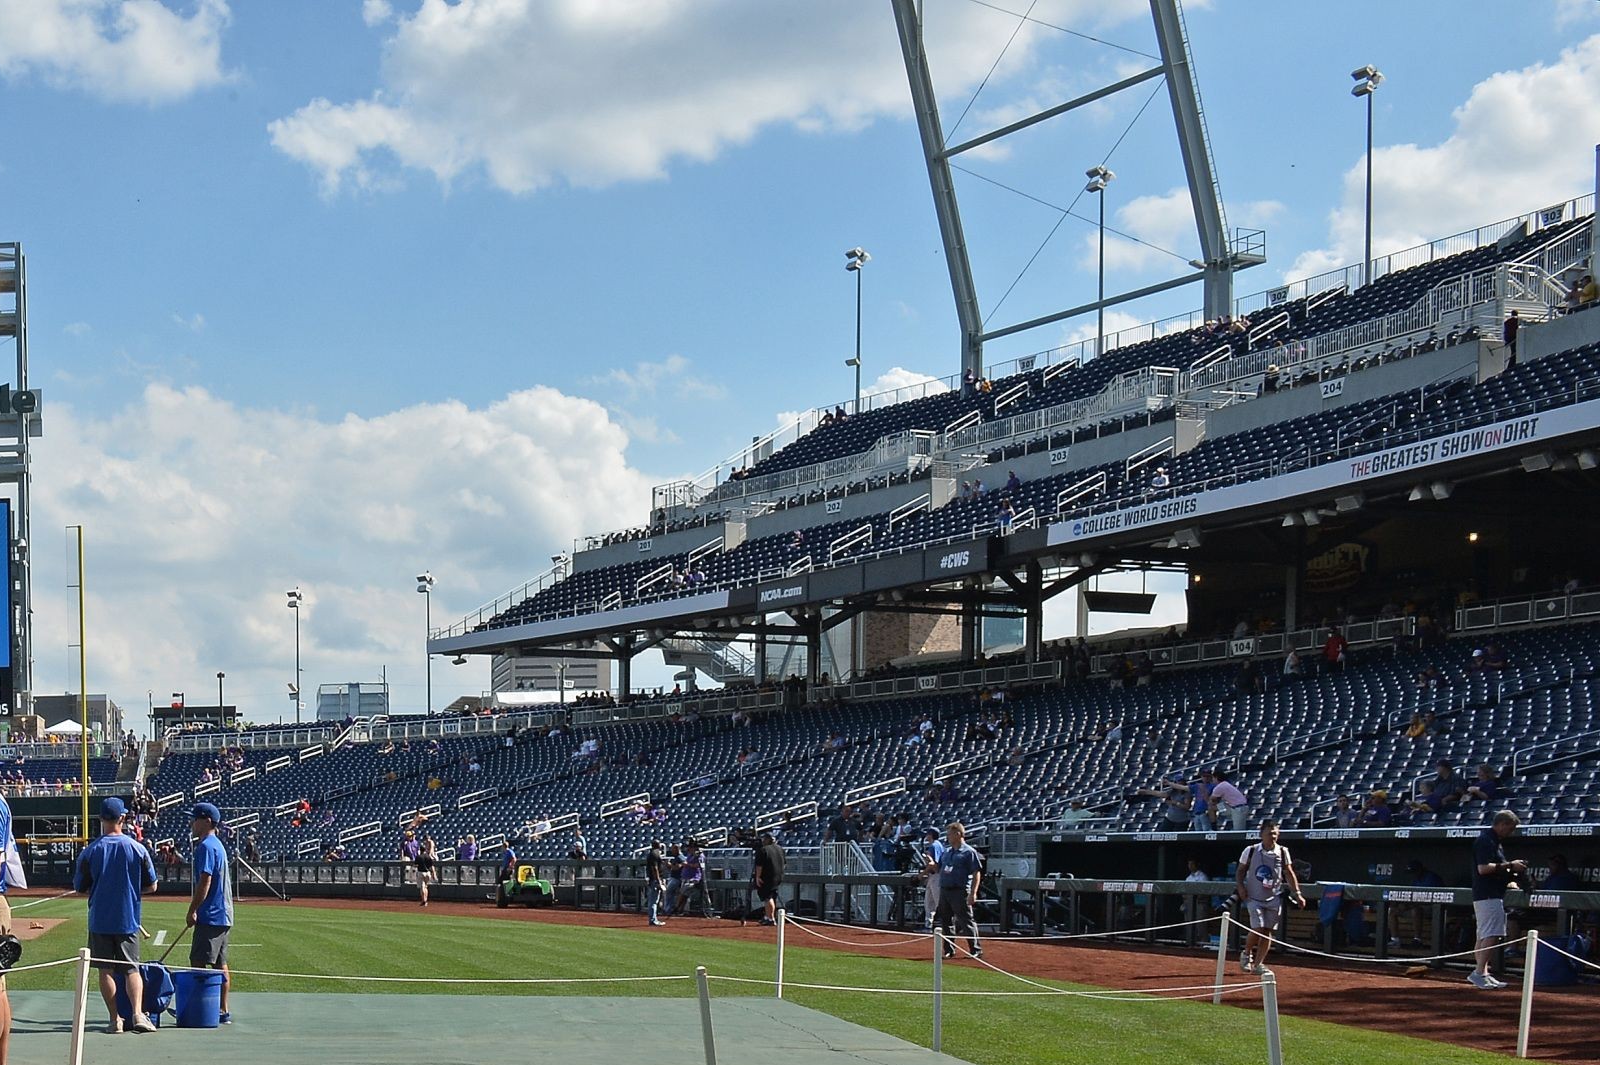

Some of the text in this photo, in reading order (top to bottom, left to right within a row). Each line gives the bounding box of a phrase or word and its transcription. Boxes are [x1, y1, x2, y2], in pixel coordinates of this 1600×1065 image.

[1544, 210, 1561, 223] 303
[1272, 291, 1287, 300] 302
[1323, 382, 1341, 395] 204
[1350, 417, 1539, 478] THE GREATEST SHOW ON DIRT
[1052, 451, 1067, 461] 203
[827, 502, 840, 511] 202
[1082, 499, 1197, 535] COLLEGE WORLD SERIES
[640, 541, 651, 549] 201
[940, 551, 970, 569] #CWS
[761, 586, 802, 602] NCAA.com
[1234, 642, 1251, 652] 104
[921, 679, 934, 687] 103
[1308, 830, 1359, 839] COLLEGE WORLD SERIES
[1395, 830, 1410, 838] #CWS
[1447, 829, 1481, 838] NCAA.com
[1526, 826, 1593, 836] COLLEGE WORLD SERIES
[51, 842, 71, 854] 335
[1376, 864, 1393, 876] CWS
[1388, 890, 1454, 903] COLLEGE WORLD SERIES
[1529, 894, 1560, 907] FLORIDA
